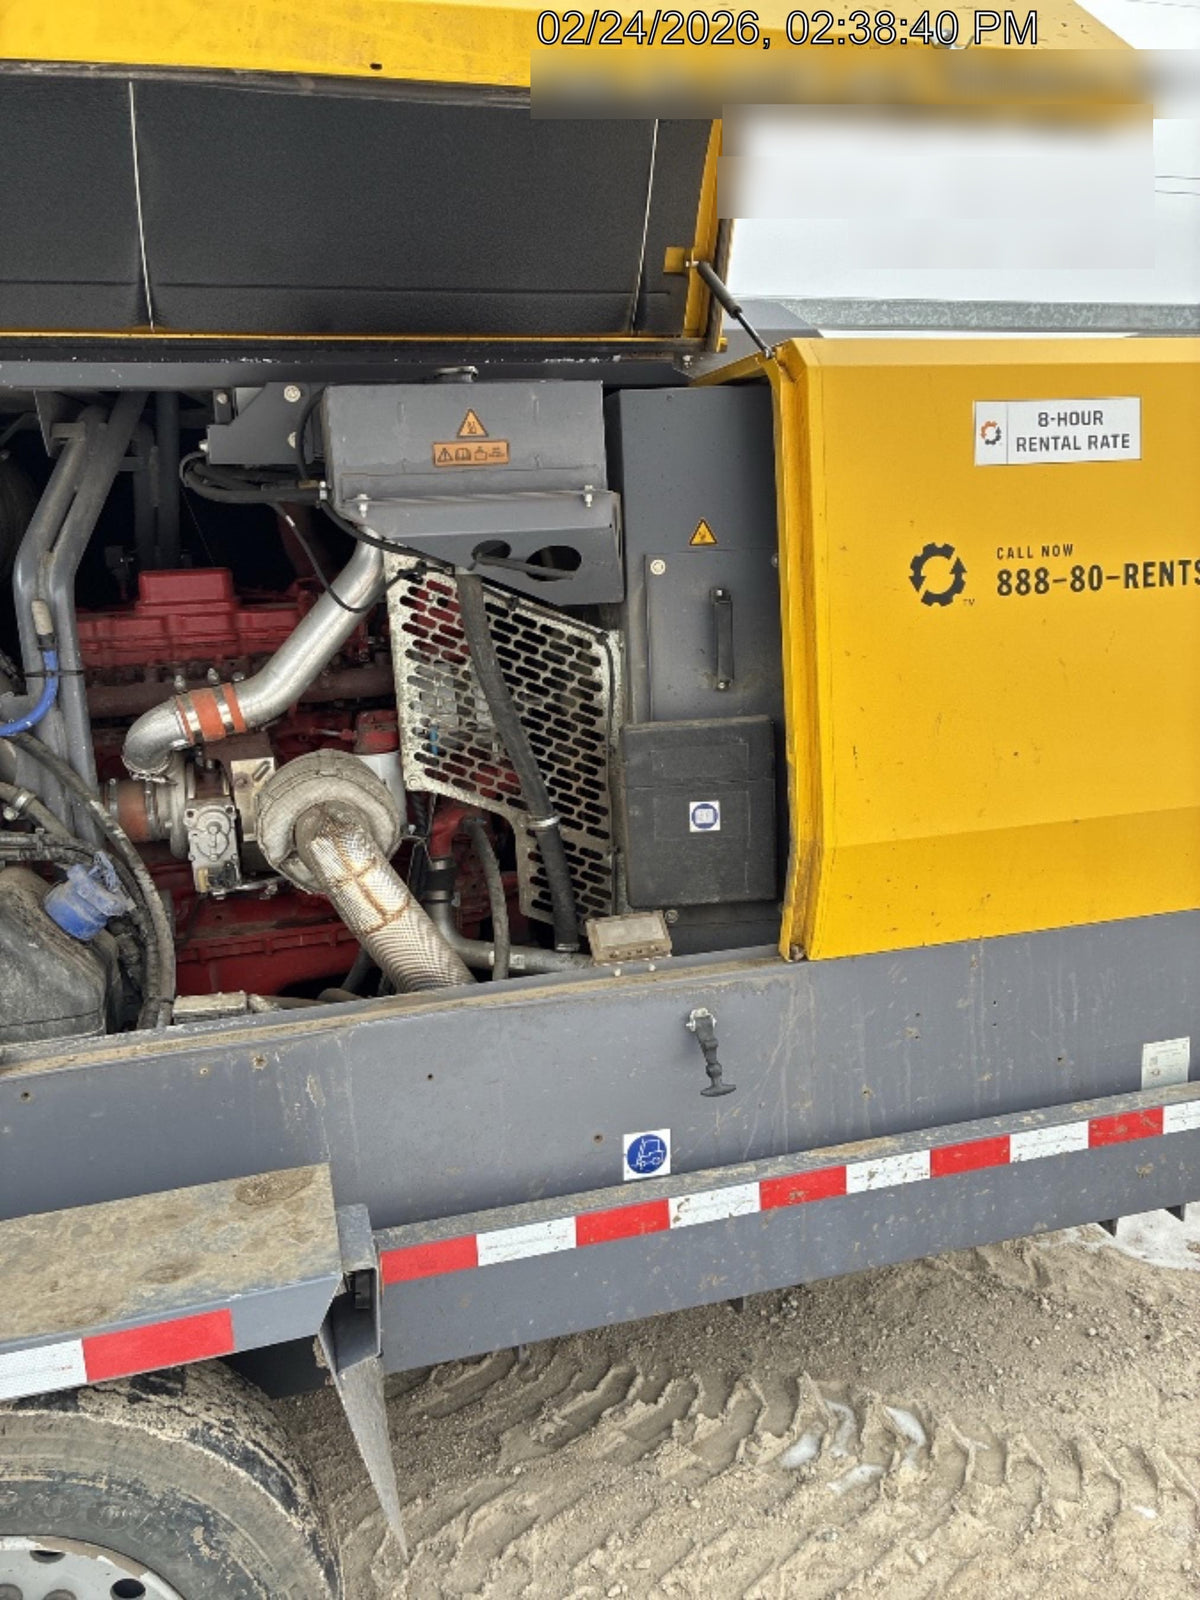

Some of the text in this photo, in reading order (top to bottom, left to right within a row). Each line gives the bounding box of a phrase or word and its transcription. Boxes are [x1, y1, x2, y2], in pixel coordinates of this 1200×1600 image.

[1037, 410, 1104, 428] 8-HOUR
[1016, 433, 1130, 452] RENTAL RATE
[996, 543, 1074, 561] CALL NOW
